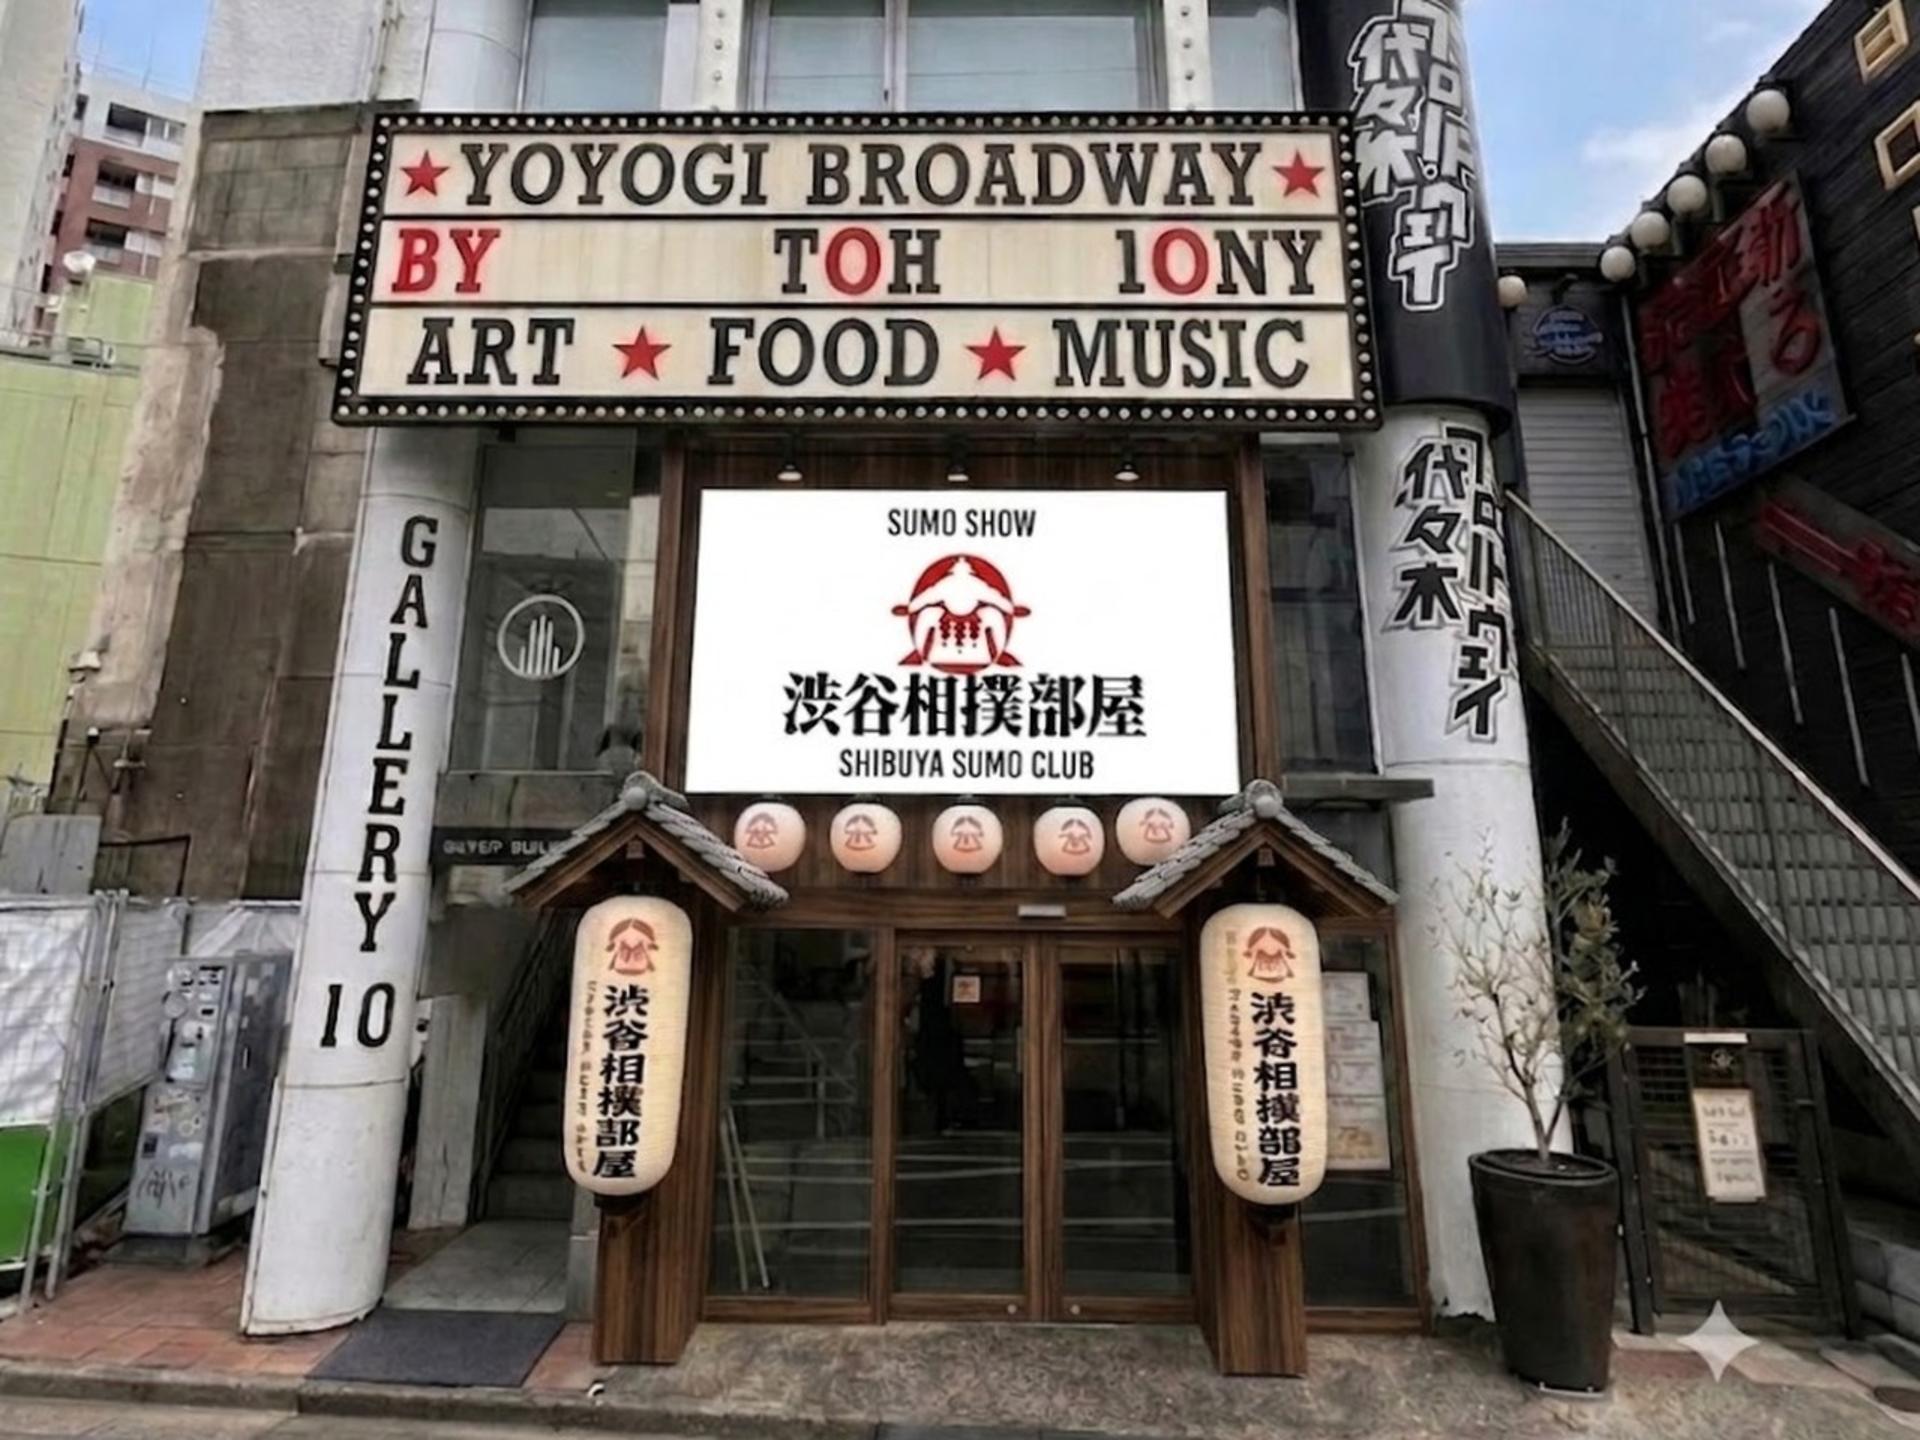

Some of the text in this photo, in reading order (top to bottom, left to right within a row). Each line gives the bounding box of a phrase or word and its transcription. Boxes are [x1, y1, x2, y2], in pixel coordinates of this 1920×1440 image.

[1355, 22, 1428, 196] 代々木
[460, 142, 1262, 206] YOYOGI BROADWAY
[390, 228, 501, 293] BY
[773, 227, 942, 295] TOH
[406, 316, 1310, 389] ART FOOD MUSIC
[887, 509, 1037, 537] SUMO SHOW
[1394, 443, 1469, 622] 代々木
[783, 671, 1147, 738] 渋谷相撲部屋
[320, 515, 438, 1048] GALLERY 10
[839, 749, 1095, 780] SHIBUYA SUMO CLUB
